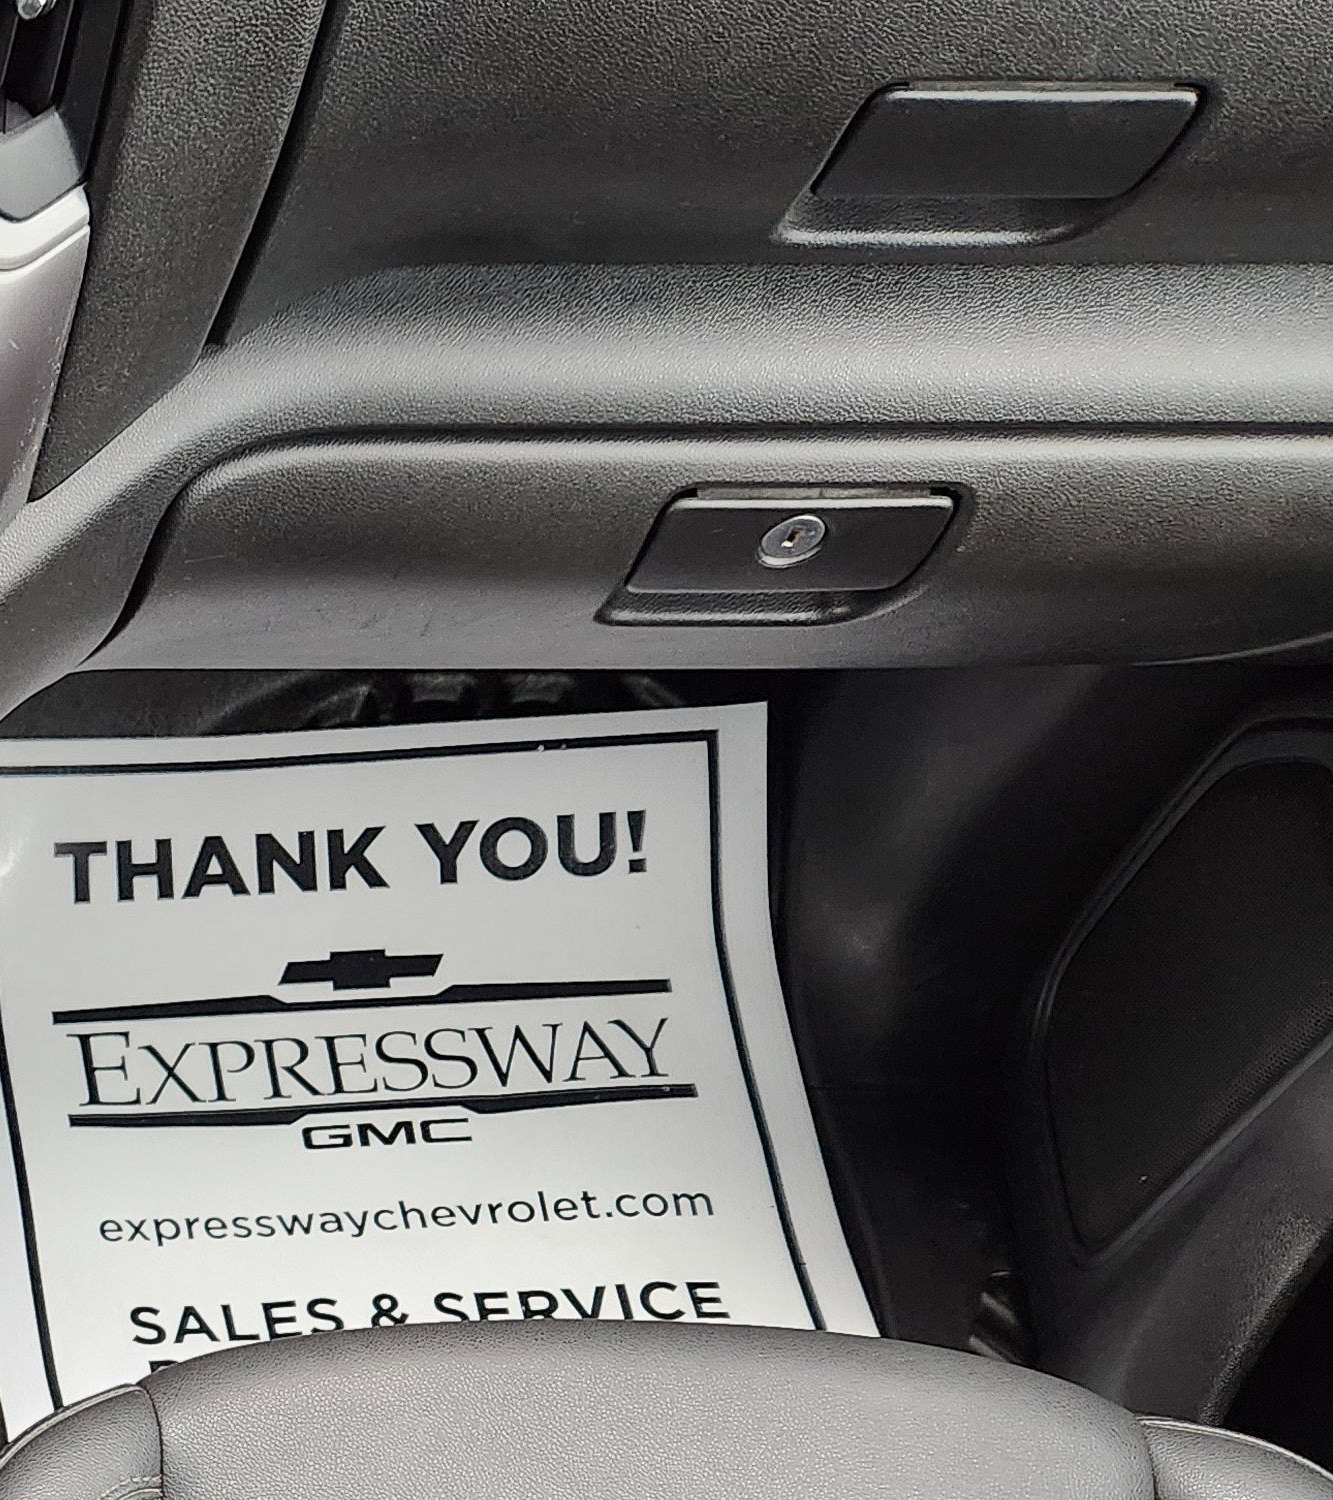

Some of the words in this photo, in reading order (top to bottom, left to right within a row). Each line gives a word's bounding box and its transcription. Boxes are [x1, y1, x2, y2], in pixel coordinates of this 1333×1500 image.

[53, 825, 391, 905] THANK
[414, 809, 648, 885] YOU!
[65, 1015, 673, 1108] EXPRESSWAY
[300, 1116, 474, 1151] GMC
[98, 1188, 715, 1248] expresswaychevrolet.com
[129, 1297, 345, 1345] SALES
[370, 1293, 410, 1328] &
[433, 1281, 731, 1322] SERVICE
